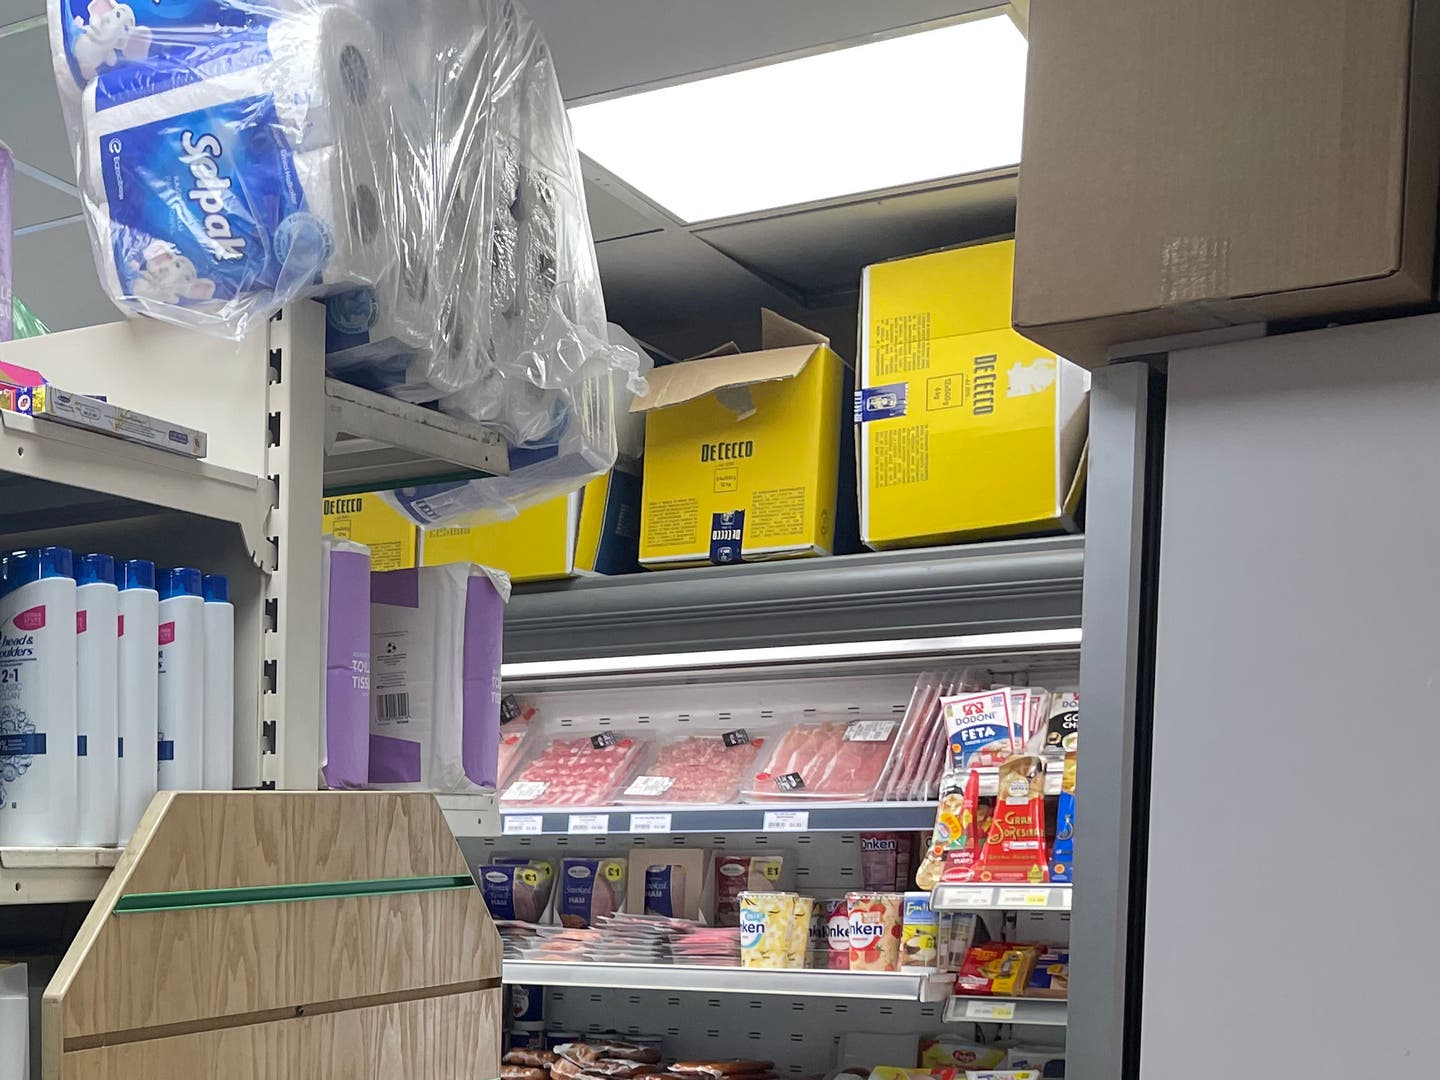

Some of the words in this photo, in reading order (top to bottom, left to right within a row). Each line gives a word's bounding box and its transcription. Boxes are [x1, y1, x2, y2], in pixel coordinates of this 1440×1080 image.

[180, 130, 247, 261] Selpak
[955, 712, 996, 726] DODONI
[961, 727, 996, 741] FETA
[1004, 812, 1032, 826] GRAN
[862, 838, 896, 850] Onken
[525, 871, 538, 883] £1
[607, 865, 620, 877] £1
[767, 867, 779, 875] £1
[568, 896, 586, 904] HAM
